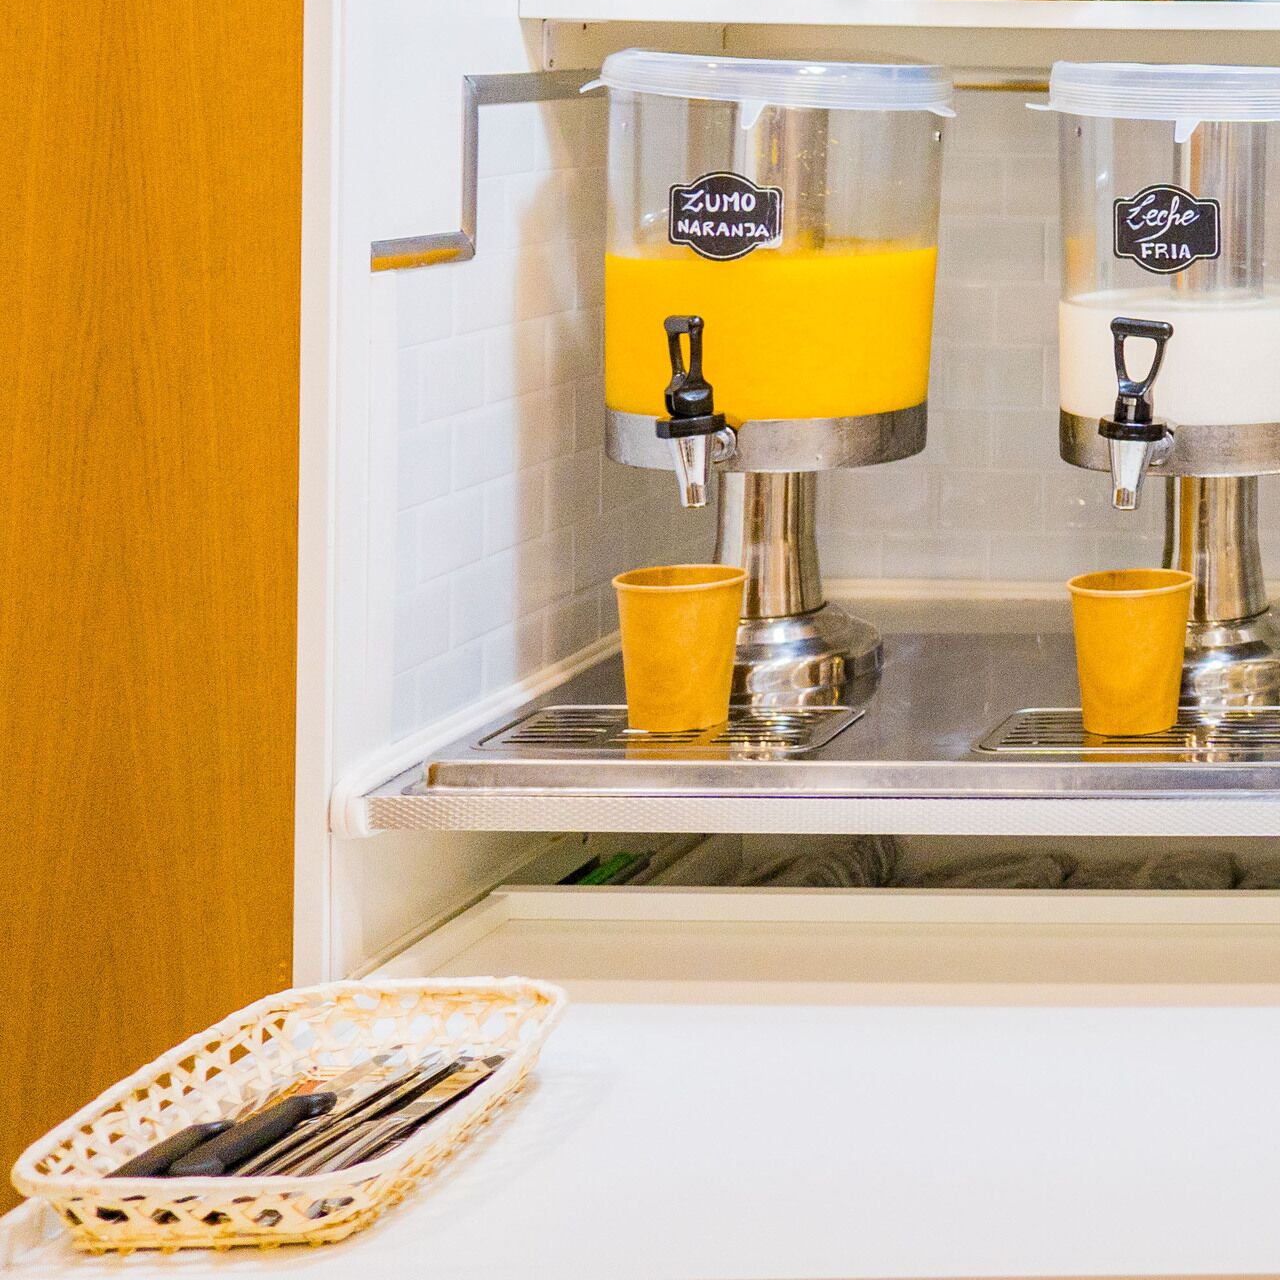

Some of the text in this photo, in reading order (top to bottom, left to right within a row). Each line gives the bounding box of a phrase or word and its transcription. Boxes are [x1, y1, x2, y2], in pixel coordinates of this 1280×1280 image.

[680, 189, 757, 213] ZUMO
[677, 219, 770, 238] NARANJA
[1126, 194, 1200, 243] Leche
[1140, 242, 1192, 260] FRIA
